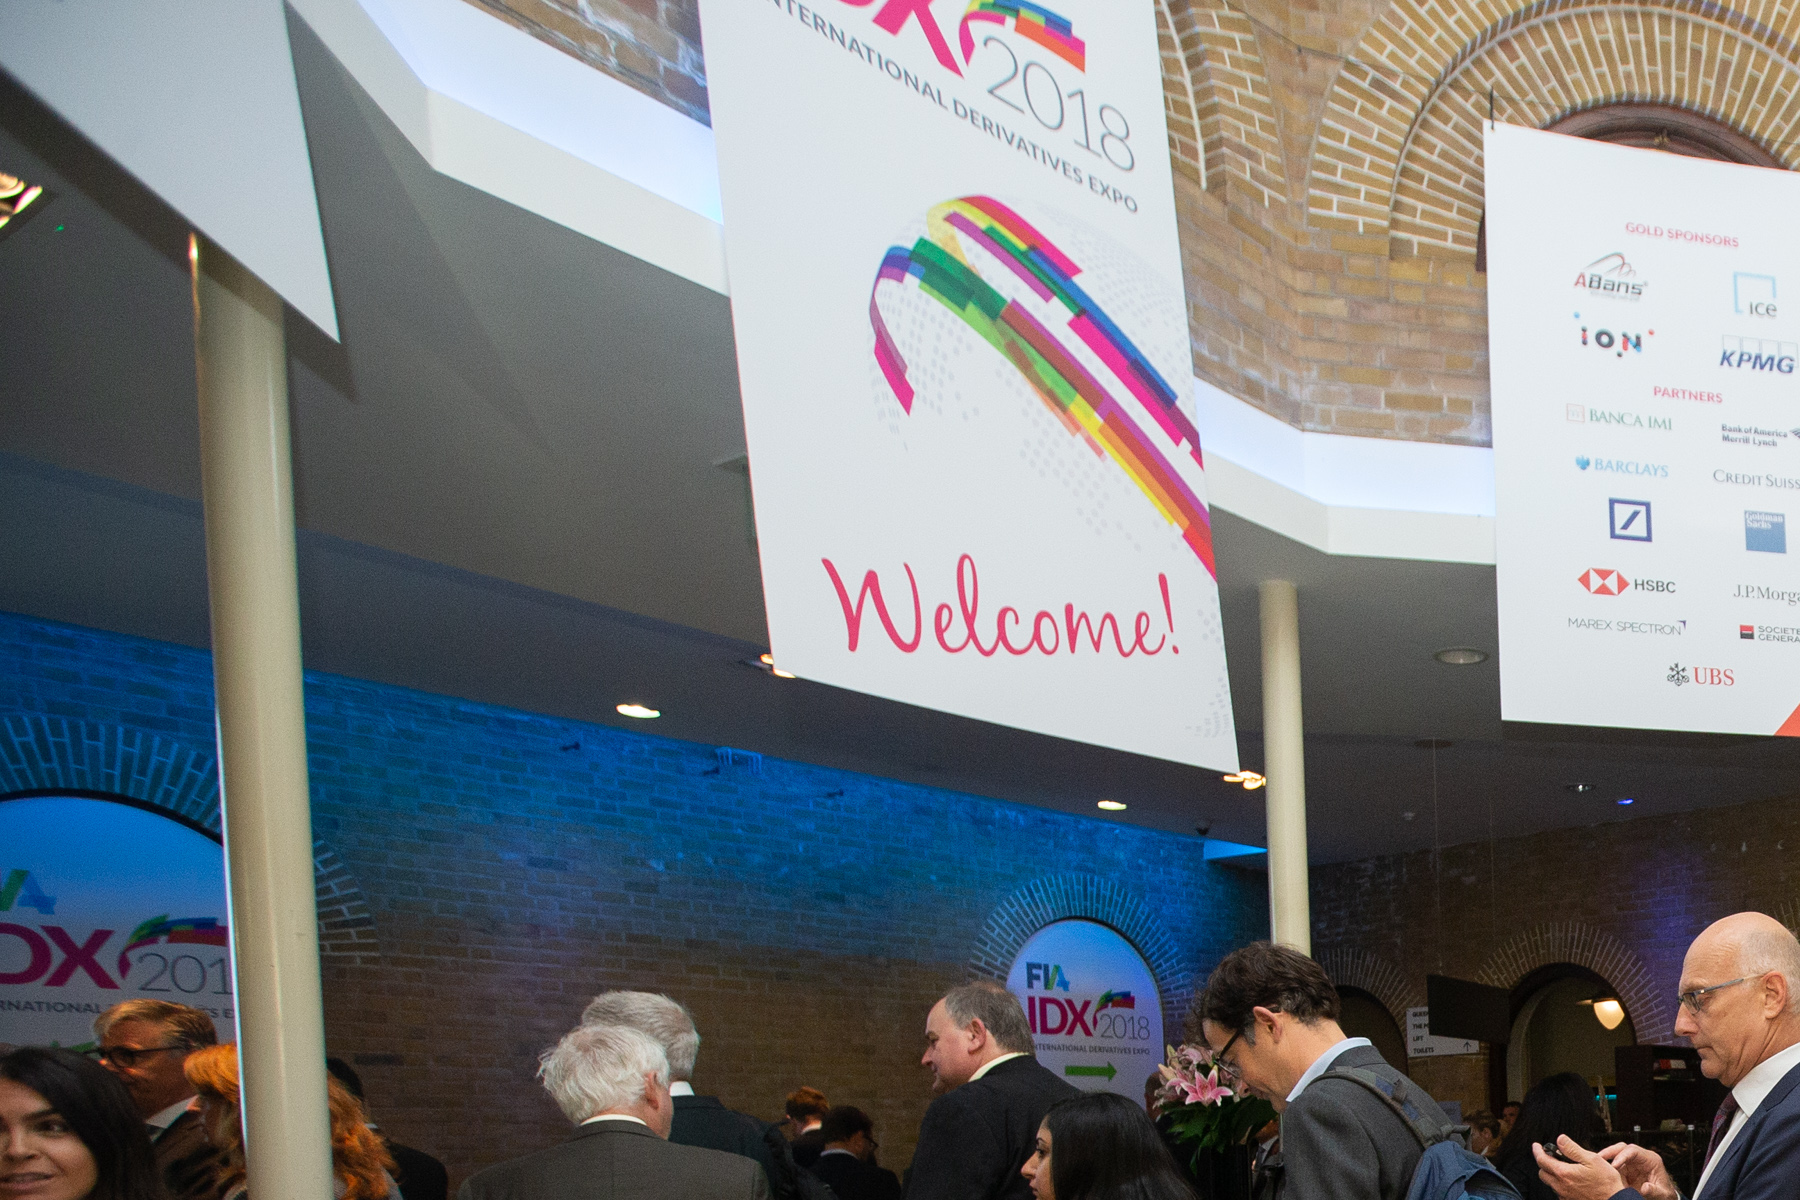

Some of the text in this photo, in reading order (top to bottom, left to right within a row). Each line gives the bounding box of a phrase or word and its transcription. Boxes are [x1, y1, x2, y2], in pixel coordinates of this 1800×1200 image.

[766, 0, 949, 110] TERNATIONAL
[952, 98, 1083, 185] DERIVATIVES
[1088, 174, 1138, 214] EXPO
[983, 35, 1136, 172] 2018
[1625, 221, 1739, 248] GOLD SPONSORS
[1720, 348, 1795, 374] KPMG
[1653, 385, 1723, 404] PARTNERS
[1589, 408, 1673, 431] BANCA IMI
[1721, 423, 1788, 438] Bank of America
[1722, 433, 1778, 447] Merrill Lynch
[1594, 457, 1669, 478] BARCLAYS
[1634, 578, 1676, 594] HSBC
[821, 553, 1180, 658] Welcome!
[1568, 617, 1682, 636] MAREX SPECTRON
[1692, 666, 1735, 687] UBS
[137, 952, 234, 995] 201
[1026, 962, 1070, 991] FIA
[1027, 995, 1151, 1041] IDX 2018
